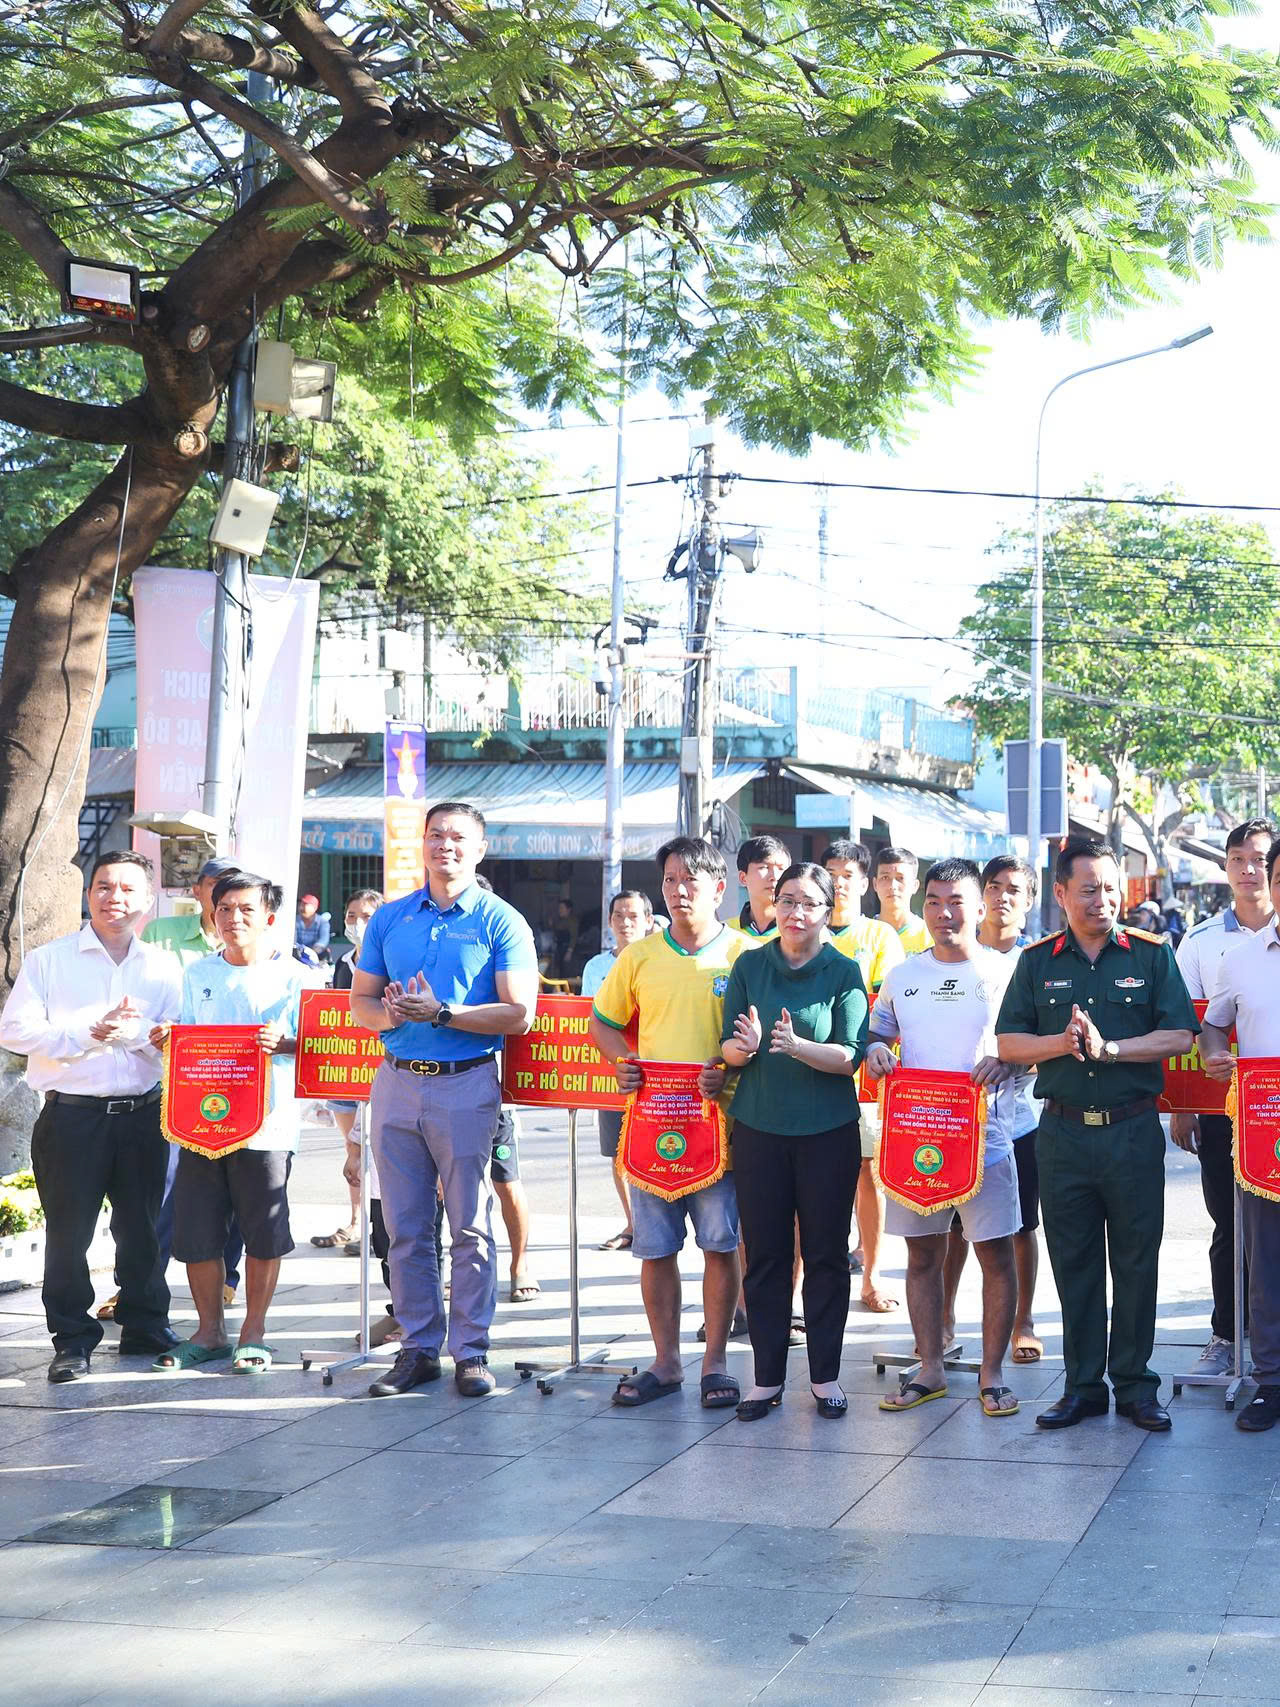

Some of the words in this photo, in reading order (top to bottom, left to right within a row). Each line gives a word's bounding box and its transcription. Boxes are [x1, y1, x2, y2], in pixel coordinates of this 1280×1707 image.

[319, 1008, 341, 1031] ĐỘI
[304, 1034, 358, 1056] PHƯỜNG
[360, 1035, 386, 1057] TÂN
[530, 1040, 558, 1062] TÂN
[562, 1042, 601, 1065] UYÊN
[318, 1063, 348, 1084] TỈNH
[351, 1062, 378, 1084] ĐỒN
[516, 1071, 535, 1089] TP.
[540, 1067, 559, 1090] HỒ
[563, 1070, 588, 1092] CHÍ
[592, 1076, 619, 1094] MIN
